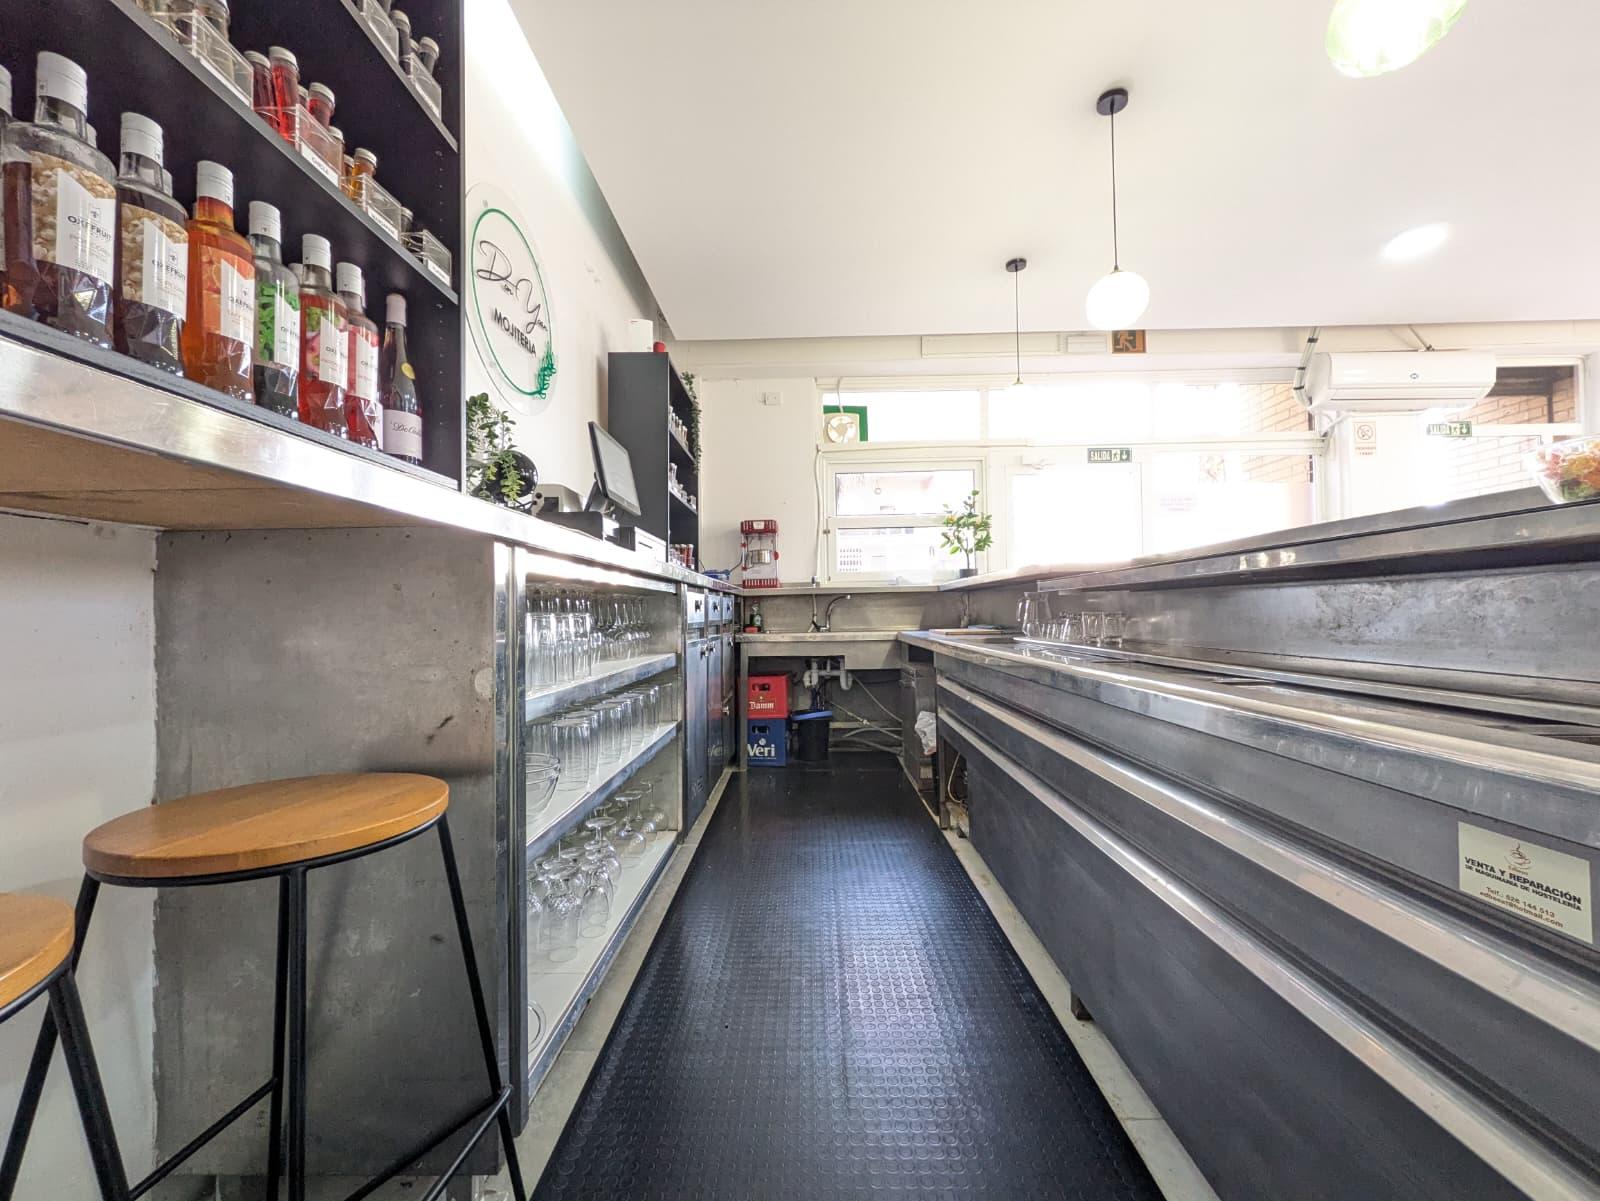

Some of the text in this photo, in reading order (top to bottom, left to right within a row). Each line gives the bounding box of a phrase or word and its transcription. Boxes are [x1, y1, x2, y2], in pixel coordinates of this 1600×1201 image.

[1090, 450, 1111, 461] SALIDA
[748, 701, 774, 710] Damm
[1464, 856, 1496, 874] VENTA
[1499, 869, 1506, 877] Y
[1509, 872, 1582, 905] REPARACIÓN
[1465, 864, 1474, 872] DE
[1520, 884, 1530, 892] DE
[1532, 888, 1582, 911] HOSTELERÍA
